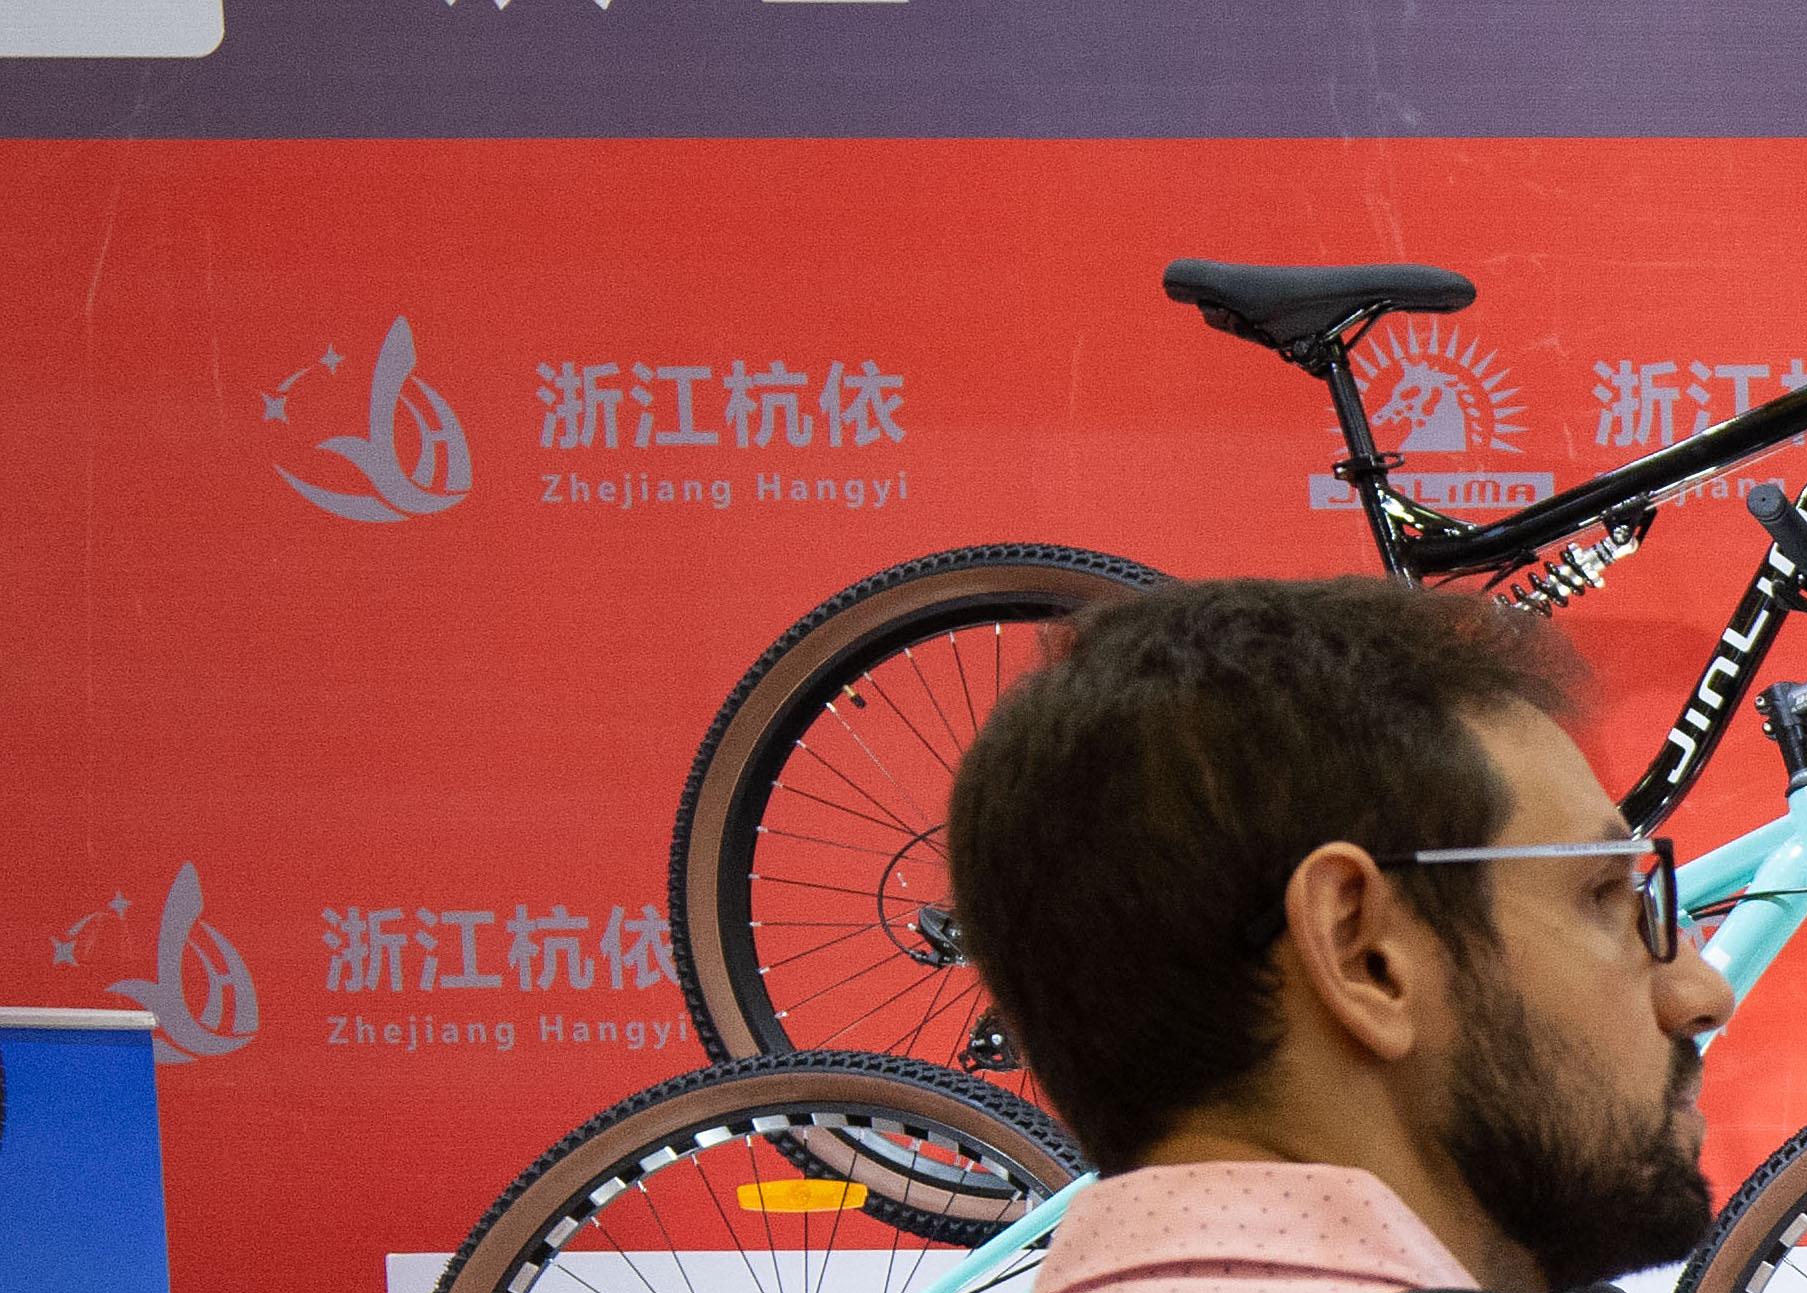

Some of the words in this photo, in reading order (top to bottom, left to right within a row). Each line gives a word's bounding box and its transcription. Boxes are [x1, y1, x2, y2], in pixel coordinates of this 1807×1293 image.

[535, 358, 908, 450] 浙江杭依
[541, 472, 733, 510] Zhejiang
[757, 471, 910, 510] Hangyi
[327, 1015, 517, 1049] Zhejiang
[540, 1012, 689, 1049] Hangyi
